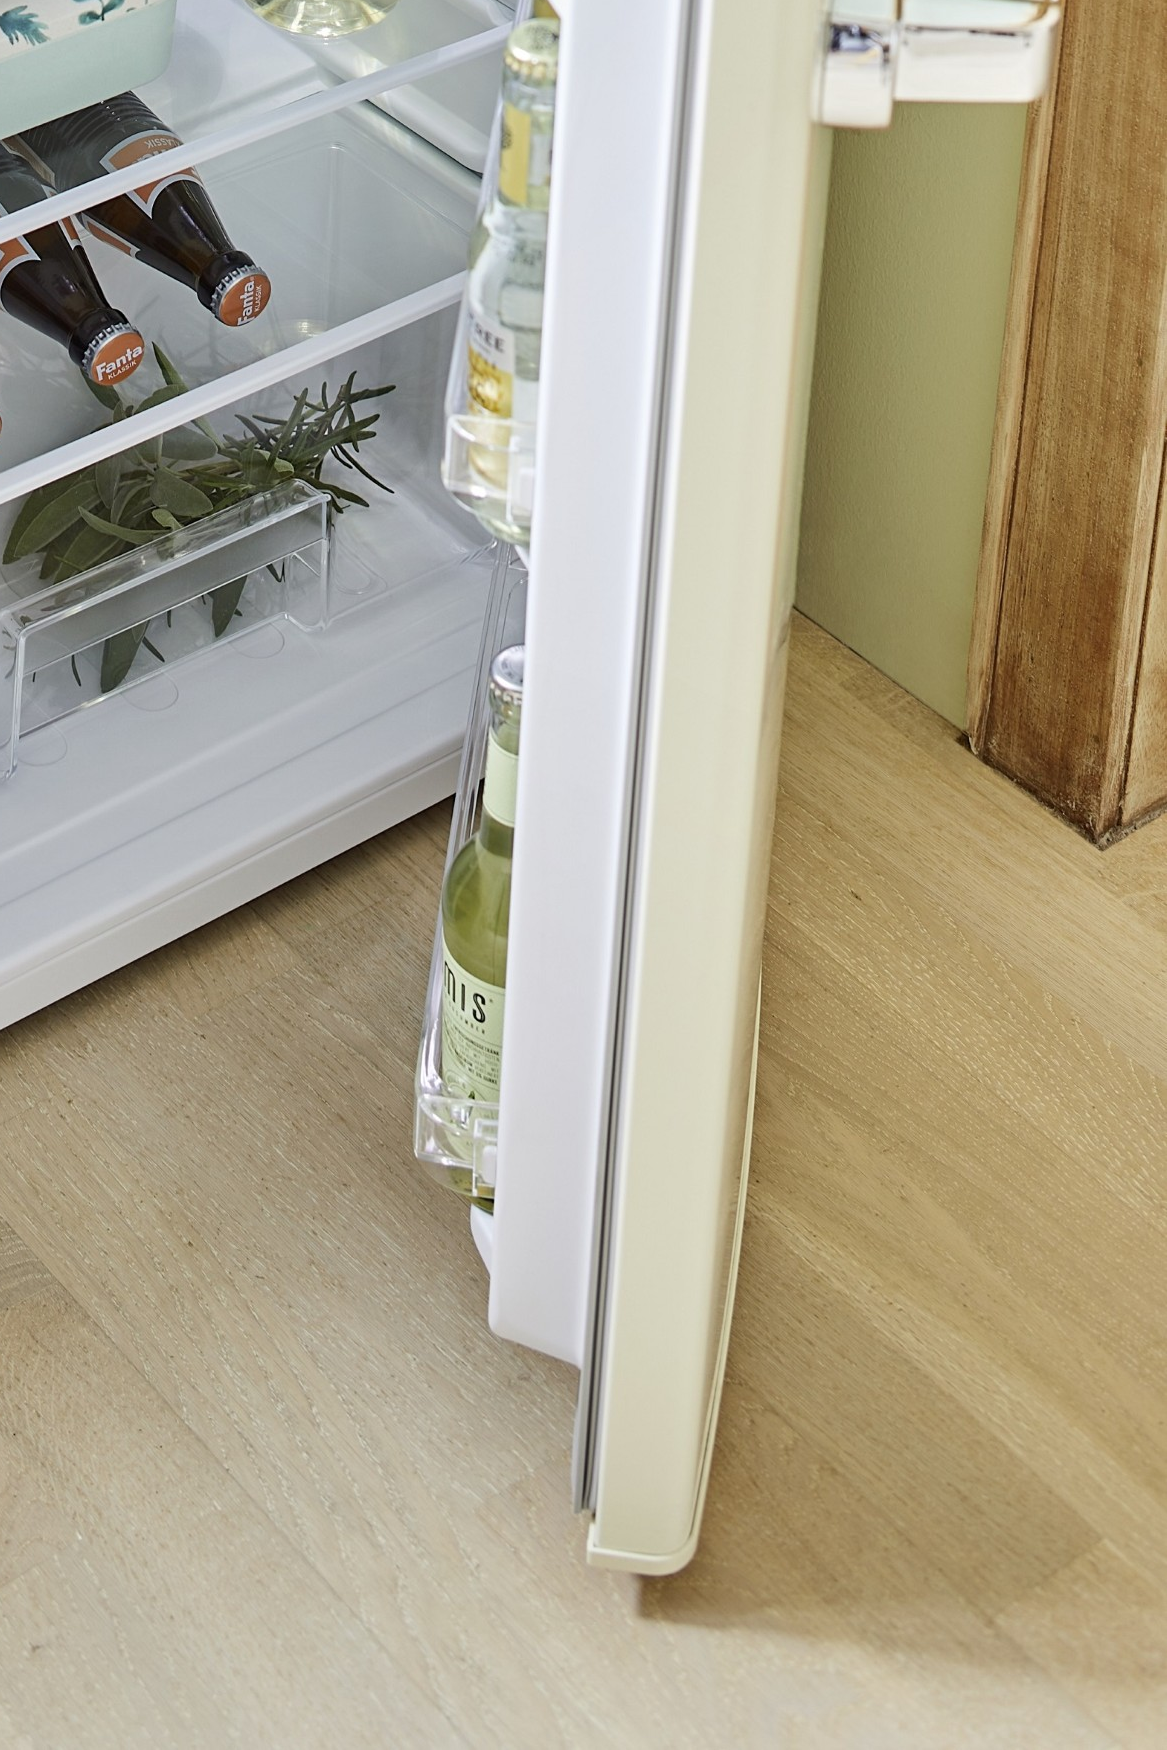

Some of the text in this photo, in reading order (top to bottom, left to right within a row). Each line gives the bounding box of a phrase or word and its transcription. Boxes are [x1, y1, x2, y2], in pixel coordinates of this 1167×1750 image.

[236, 280, 255, 326] Fanta
[254, 284, 262, 312] KLASSIK
[96, 346, 143, 381] Fanta
[107, 359, 137, 380] KLASSIK
